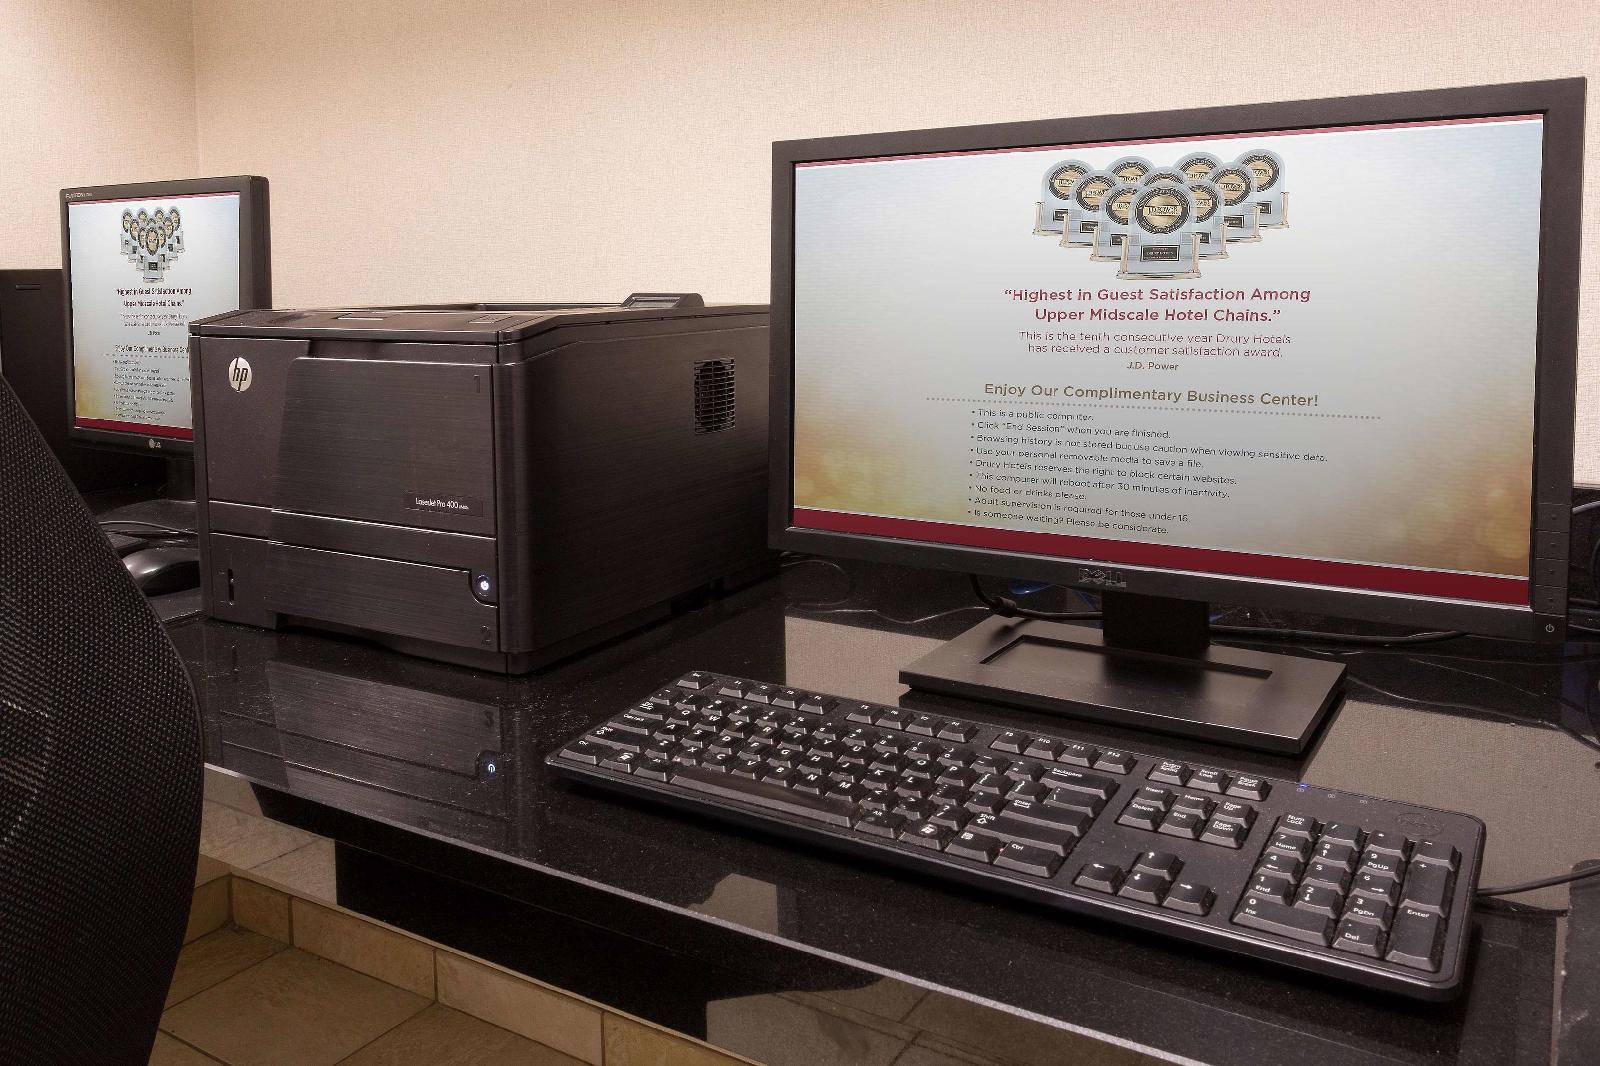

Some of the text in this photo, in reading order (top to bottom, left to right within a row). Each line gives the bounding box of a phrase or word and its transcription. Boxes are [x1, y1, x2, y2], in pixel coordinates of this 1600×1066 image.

[1077, 289, 1091, 300] in
[1097, 288, 1143, 300] Guest
[1149, 288, 1244, 300] Satisfaction
[1250, 288, 1310, 302] Among
[1035, 308, 1084, 323] Upper
[1089, 309, 1159, 320] Midscale
[1164, 309, 1207, 320] Hotel
[1018, 331, 1041, 340] This
[1045, 331, 1053, 340] is
[1057, 332, 1075, 340] the
[1079, 332, 1109, 341] tenth
[1113, 333, 1183, 342] consecutive
[1187, 335, 1212, 344] year
[1216, 334, 1249, 345] Drury
[1028, 344, 1047, 352] has
[1051, 344, 1099, 353] received
[1113, 345, 1169, 354] customer
[1171, 346, 1239, 356] satisfaction
[1243, 348, 1282, 356] award.
[1148, 361, 1178, 370] Power
[231, 358, 250, 392] hp
[984, 383, 1317, 406] Enjoy Our Complimentary Business Center!
[978, 408, 996, 416] This
[1016, 410, 1044, 420] public
[977, 420, 999, 429] Click
[1066, 426, 1091, 434] when
[1094, 428, 1111, 437] you
[1131, 429, 1170, 438] finished.
[976, 434, 1018, 445] Browsing
[1021, 436, 1052, 447] history
[1083, 440, 1112, 449] stored
[1152, 444, 1187, 453] caution
[1190, 446, 1215, 455] when
[1218, 448, 1255, 459] viewing
[1258, 451, 1300, 460] sensitive
[1303, 452, 1327, 461] data.
[976, 446, 992, 454] Use
[995, 449, 1014, 457] your
[1018, 450, 1056, 458] personal
[1110, 455, 1138, 464] media
[1141, 456, 1151, 464] to
[1187, 459, 1203, 468] file.
[975, 459, 1000, 470] Drury
[1034, 464, 1072, 473] reserves
[1075, 466, 1089, 474] the
[1092, 467, 1114, 477] right
[1117, 468, 1126, 477] to
[1129, 469, 1154, 479] block
[1157, 472, 1189, 481] certain
[1192, 474, 1236, 484] websites.
[974, 471, 993, 480] This
[1041, 476, 1056, 485] will
[1059, 478, 1090, 487] reboot
[1092, 480, 1114, 489] after
[1117, 482, 1129, 490] 30
[990, 485, 1010, 494] food
[1025, 488, 1052, 497] drinks
[415, 497, 436, 507] LaserJet
[446, 501, 459, 509] 400
[1063, 505, 1101, 514] required
[1105, 507, 1118, 516] for
[1120, 508, 1146, 518] those
[1148, 512, 1176, 521] under
[983, 511, 1023, 520] someone
[1026, 514, 1063, 526] waiting?
[1066, 517, 1095, 527] Please
[1097, 520, 1109, 528] be
[1112, 523, 1168, 534] considerate.
[980, 813, 996, 821] Shift
[1275, 842, 1297, 850] Home
[1368, 862, 1389, 870] PgUp
[1255, 885, 1271, 893] End
[1353, 908, 1374, 916] PgDn
[1407, 909, 1430, 918] Enter
[1345, 932, 1360, 941] Del
